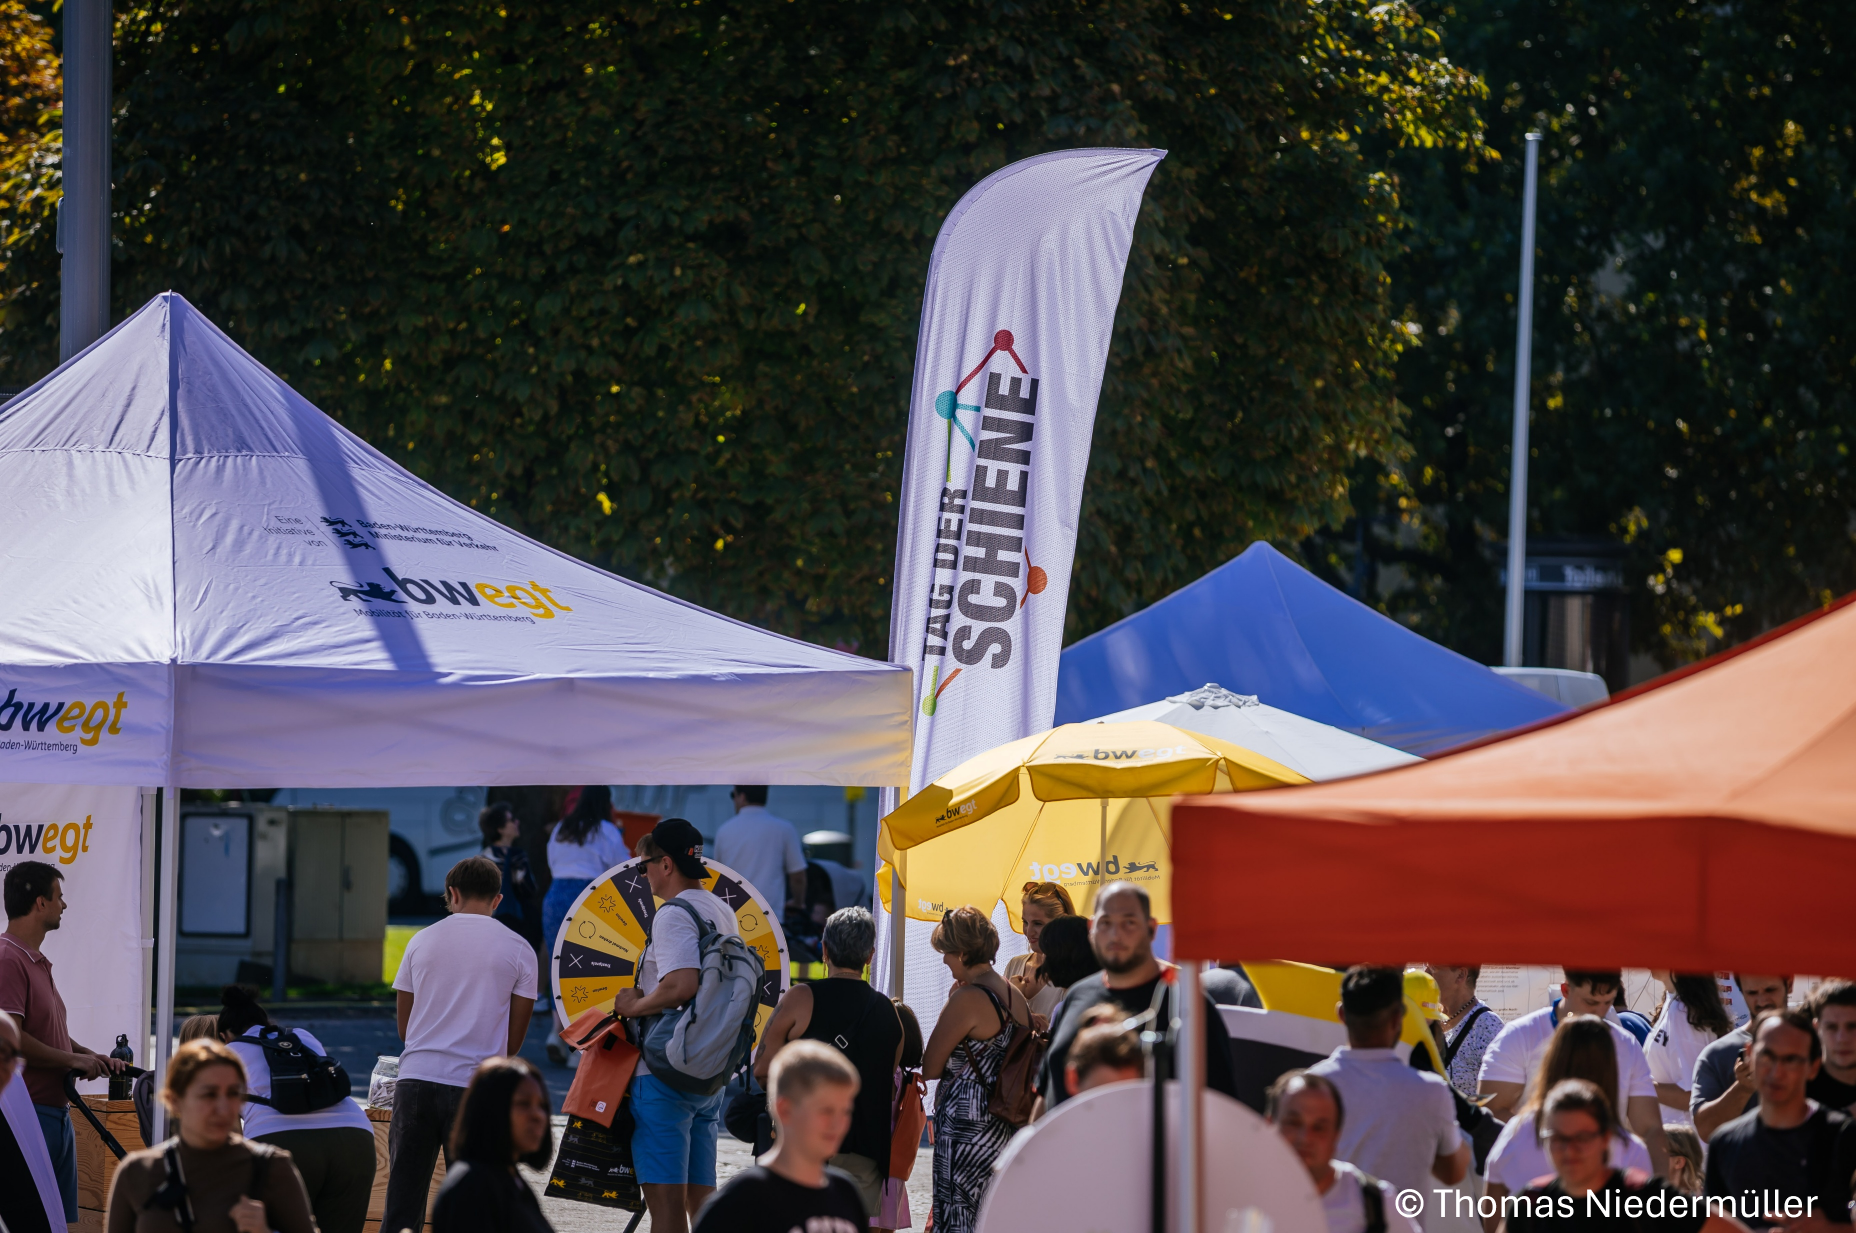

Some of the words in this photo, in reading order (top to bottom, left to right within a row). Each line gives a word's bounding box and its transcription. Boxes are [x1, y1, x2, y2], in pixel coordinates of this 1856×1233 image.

[274, 515, 304, 525] Eine
[933, 486, 968, 570] DER
[952, 371, 1040, 670] SCHIENE
[262, 526, 316, 536] Initiative
[356, 519, 474, 541] Baden-Württemberg
[303, 539, 328, 547] von
[367, 531, 438, 545] Ministerium
[436, 537, 456, 547] für
[456, 539, 499, 552] Verkehr
[382, 566, 574, 619] bwegt
[353, 608, 404, 619] Mobilität
[404, 609, 422, 620] für
[424, 611, 536, 625] Baden-Württemberg
[922, 584, 954, 661] TAG
[0, 688, 128, 747] bwegt
[0, 739, 78, 755] aden-Württemberg
[1093, 744, 1188, 760] bwegt
[946, 798, 978, 819] bwegt
[615, 912, 628, 927] Gewinn
[619, 1164, 634, 1175] bwe
